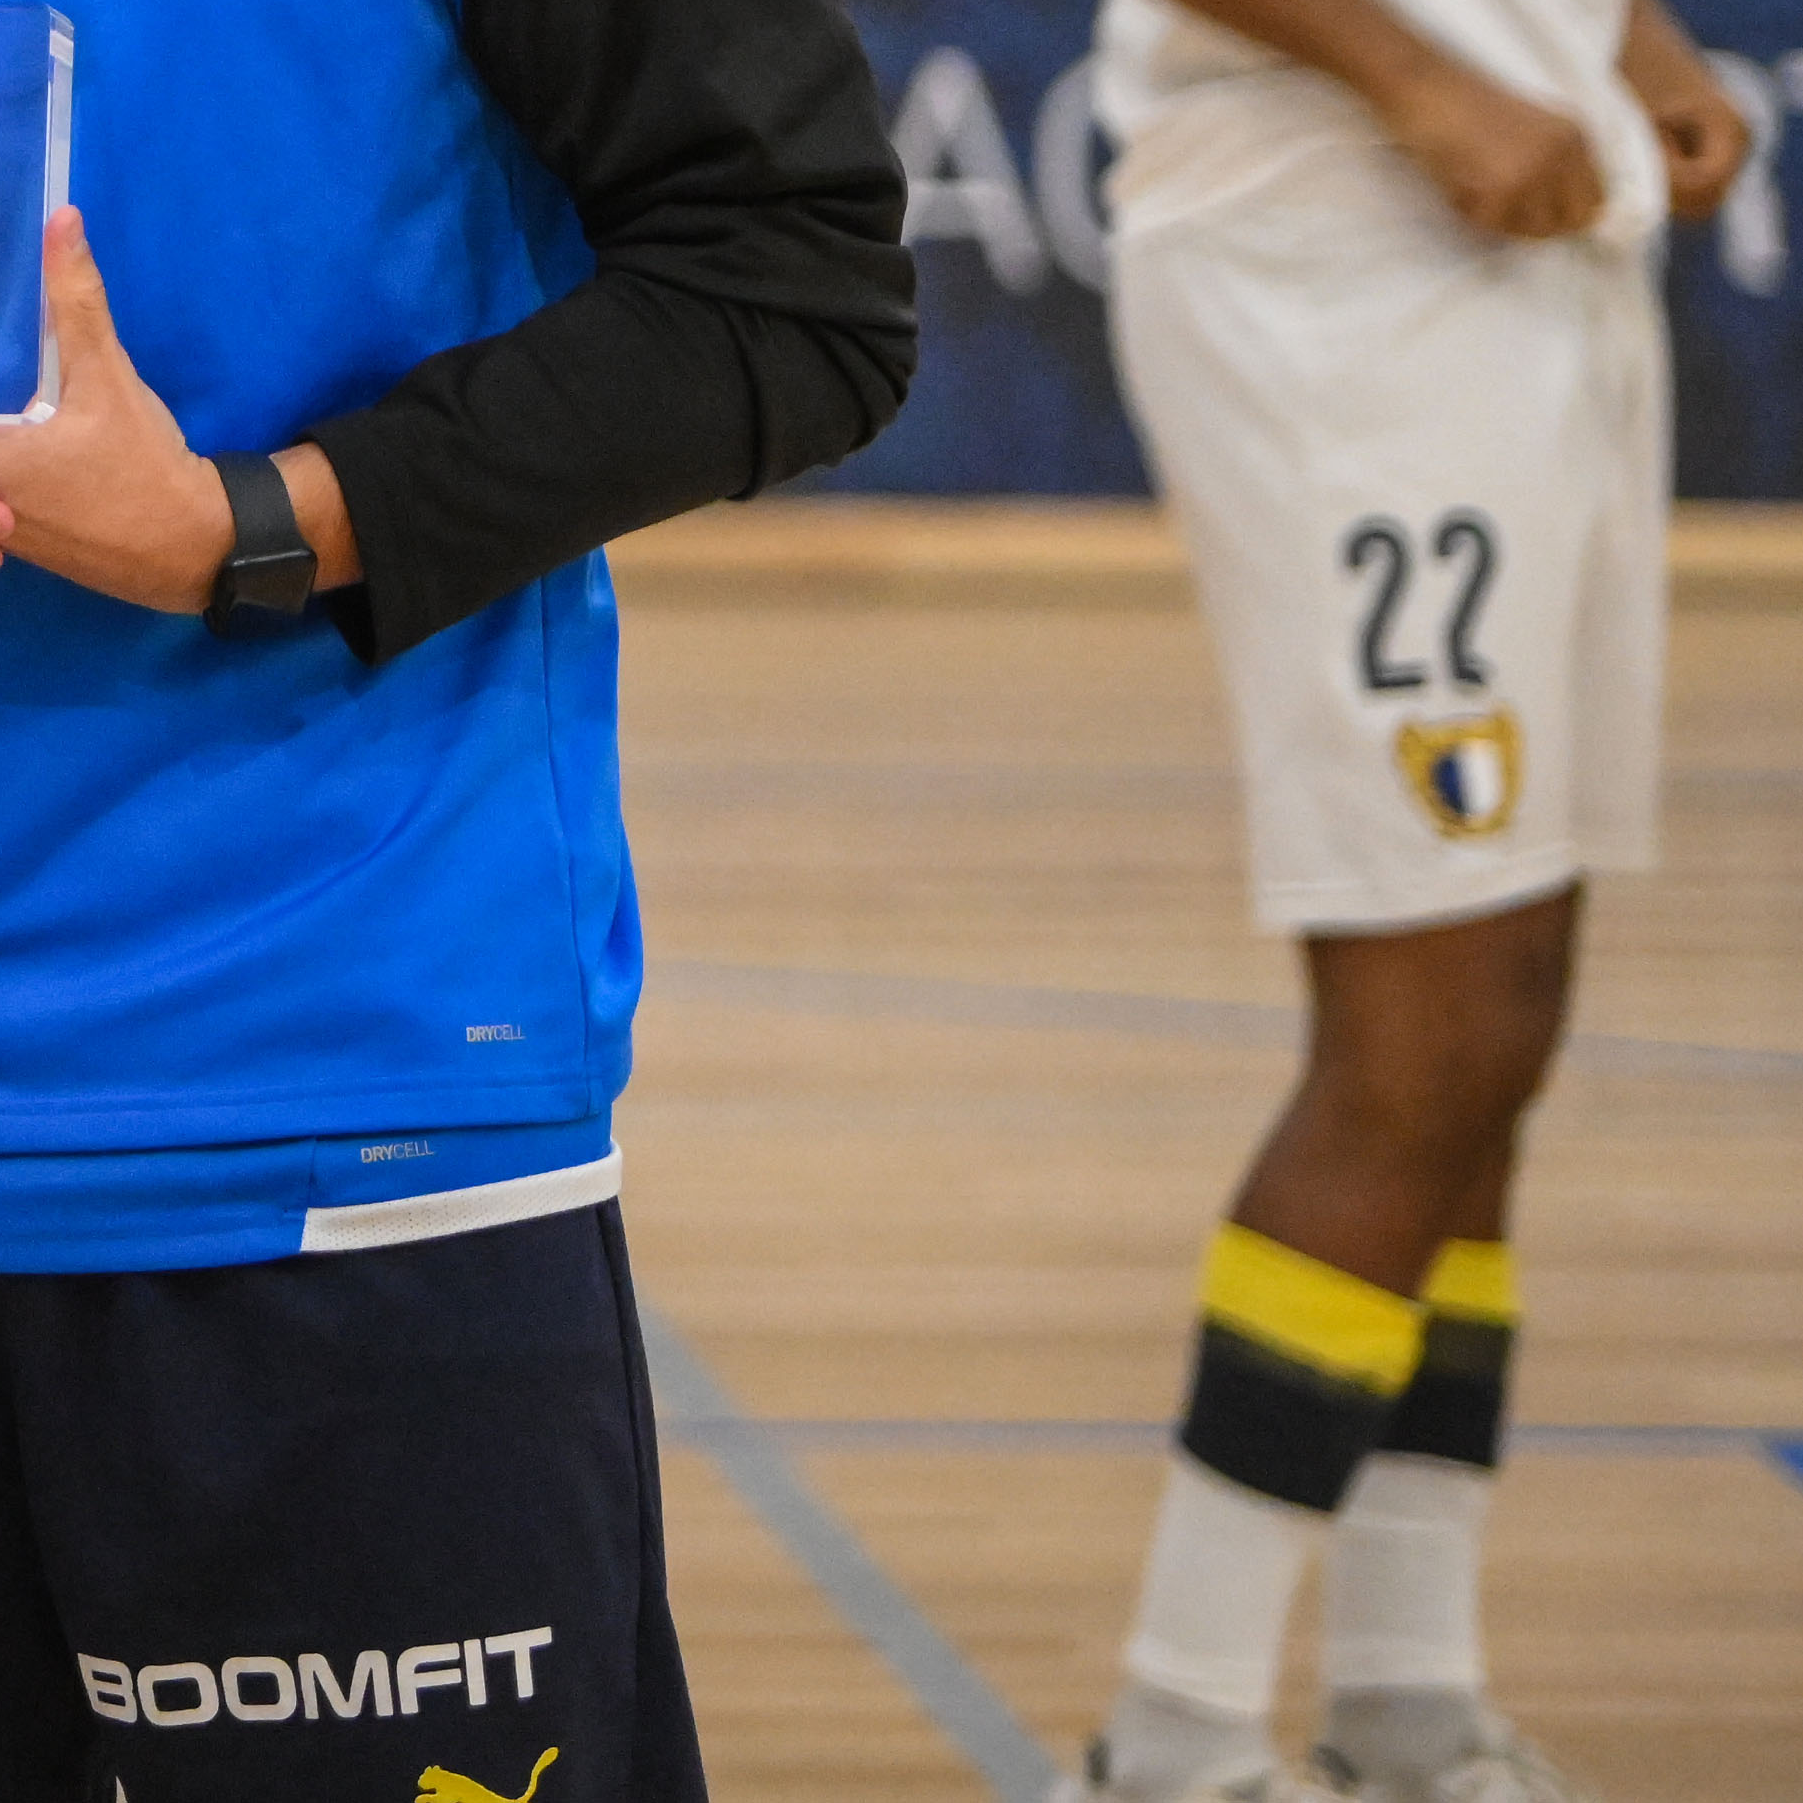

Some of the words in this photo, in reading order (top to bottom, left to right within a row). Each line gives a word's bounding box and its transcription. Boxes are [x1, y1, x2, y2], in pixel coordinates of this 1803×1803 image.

[1341, 513, 1498, 691] 22
[465, 1023, 526, 1043] DRYCELL
[359, 1139, 436, 1165] DRYCELL
[77, 1625, 553, 1727] BOOMFIT
